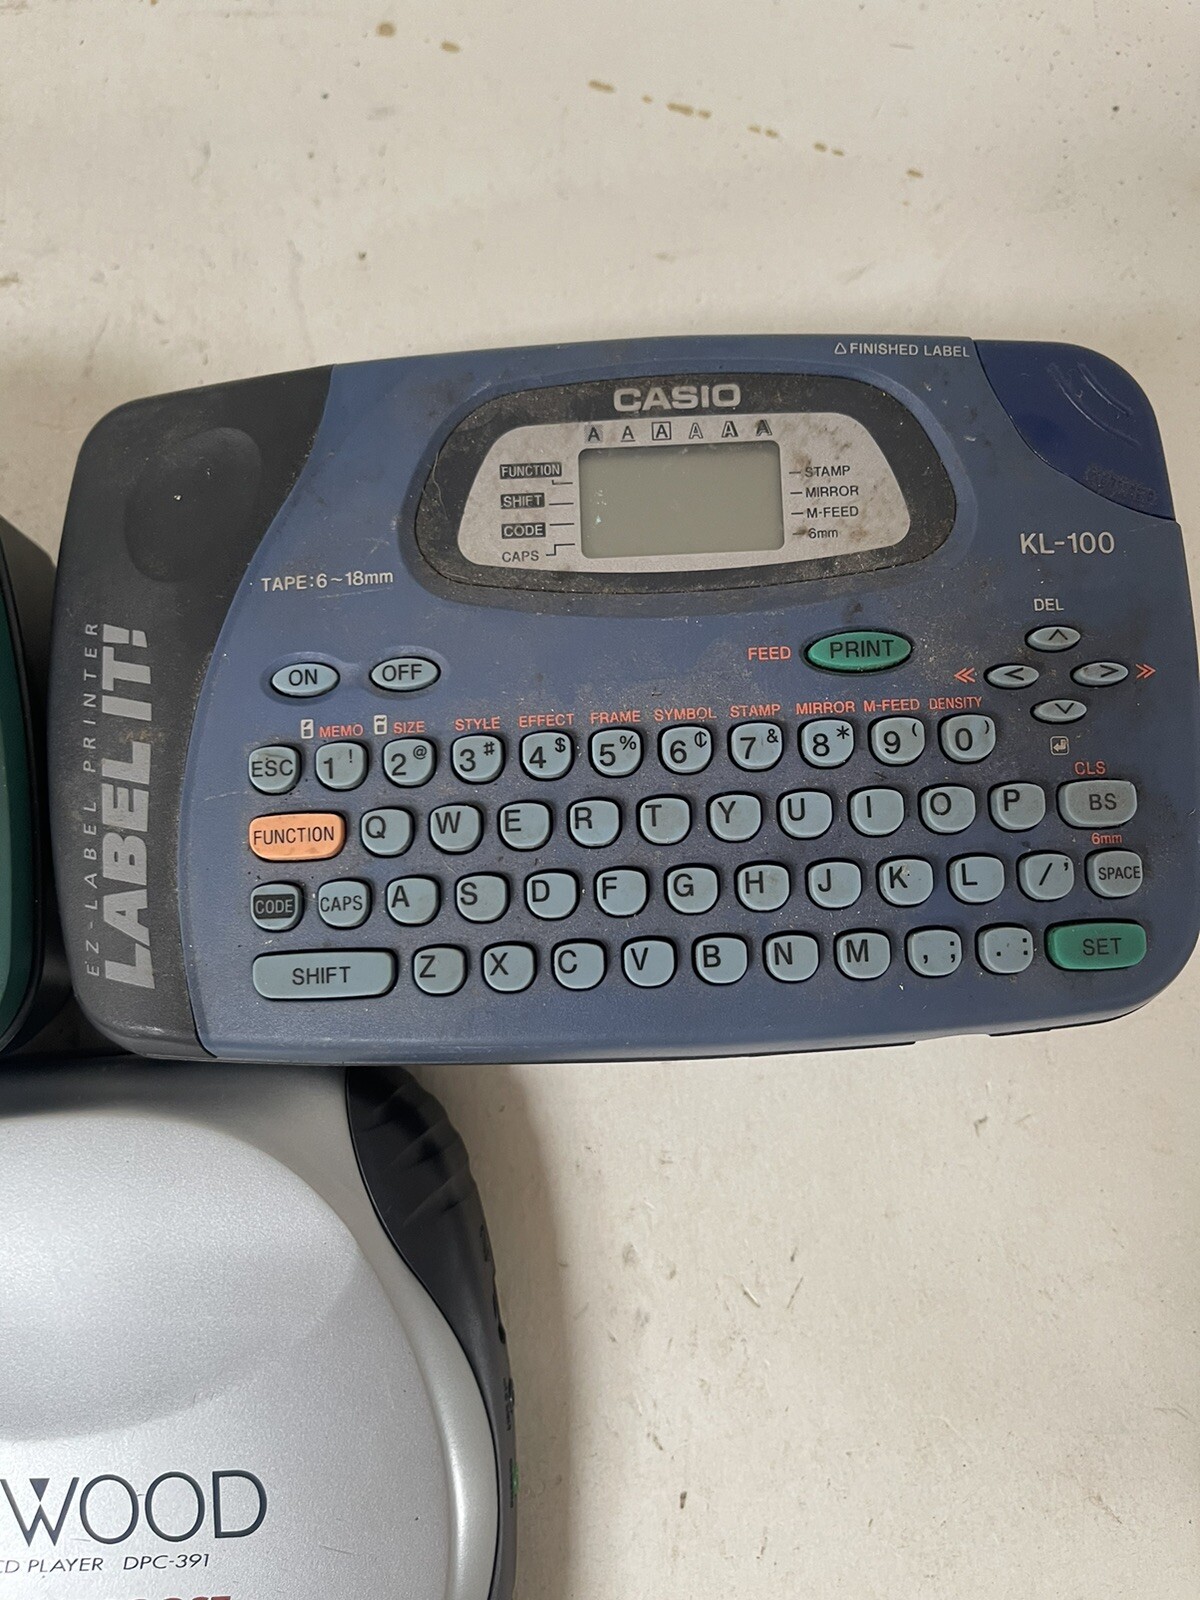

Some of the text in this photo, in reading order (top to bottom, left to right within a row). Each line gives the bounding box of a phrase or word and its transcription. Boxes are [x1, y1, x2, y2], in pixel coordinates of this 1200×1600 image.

[850, 343, 970, 357] FINISHED LABEL
[613, 383, 741, 412] CASIO
[621, 425, 635, 440] A
[689, 422, 703, 439] A
[721, 421, 738, 438] A
[756, 419, 772, 436] A
[501, 464, 560, 477] FUNCTION
[805, 466, 850, 478] STAMP
[503, 495, 542, 507] SHIFT
[805, 486, 859, 498] MIRROR
[806, 506, 859, 518] M-FEED
[503, 524, 543, 537] CODE
[808, 528, 838, 539] 6mm
[1019, 531, 1115, 555] KL-100
[502, 551, 539, 562] CAPS
[1034, 598, 1064, 612] DEL
[748, 646, 791, 661] FEED
[829, 640, 894, 659] PRINT
[288, 668, 318, 686] ON
[382, 663, 423, 682] OFF
[83, 623, 98, 772] PRINTER
[796, 701, 855, 715] MIRROR
[864, 699, 920, 712] M-FEED
[929, 697, 982, 710] DENSITY
[519, 713, 575, 728] EFFECT
[590, 710, 641, 724] FRAME
[654, 708, 717, 722] SYMBOL
[730, 704, 781, 717] STAMP
[319, 724, 364, 738] MEMO
[393, 721, 425, 734] SIZE
[455, 716, 500, 731] STYLE
[740, 736, 756, 760] 7
[812, 733, 829, 757] 8
[883, 731, 900, 754] 9
[955, 728, 973, 751] 0
[459, 748, 476, 772] 3
[529, 746, 547, 768] 4
[599, 743, 616, 767] 5
[670, 740, 687, 763] 6
[252, 759, 293, 777] ESC
[323, 757, 334, 779] 1
[391, 753, 407, 776] 2
[1074, 762, 1107, 775] CLS
[101, 623, 155, 989] LABEL IT!
[788, 798, 805, 821] U
[866, 796, 872, 818] I
[930, 792, 951, 816] O
[1004, 789, 1021, 812] P
[1089, 794, 1117, 811] BS
[435, 811, 462, 834] W
[505, 809, 522, 832] E
[575, 807, 593, 830] R
[645, 804, 662, 827] T
[717, 801, 736, 824] Y
[253, 826, 335, 846] FUNCTION
[366, 815, 387, 840] Q
[1092, 832, 1122, 845] 6mm
[745, 871, 764, 894] H
[818, 869, 832, 892] J
[889, 866, 908, 889] K
[961, 863, 978, 886] L
[1039, 862, 1053, 886] /
[1098, 865, 1140, 881] SPACE
[391, 885, 410, 908] A
[460, 882, 478, 906] S
[532, 880, 550, 902] D
[602, 877, 617, 900] F
[673, 874, 694, 897] G
[255, 899, 293, 914] CODE
[320, 896, 363, 912] CAPS
[703, 945, 720, 968] B
[775, 942, 792, 965] N
[847, 940, 869, 962] M
[1082, 938, 1122, 956] SET
[420, 956, 436, 978] Z
[489, 952, 509, 976] X
[558, 950, 577, 974] C
[630, 948, 648, 971] V
[292, 967, 351, 985] SHIFT
[0, 1554, 210, 1574] D PLAYER DPC-391
